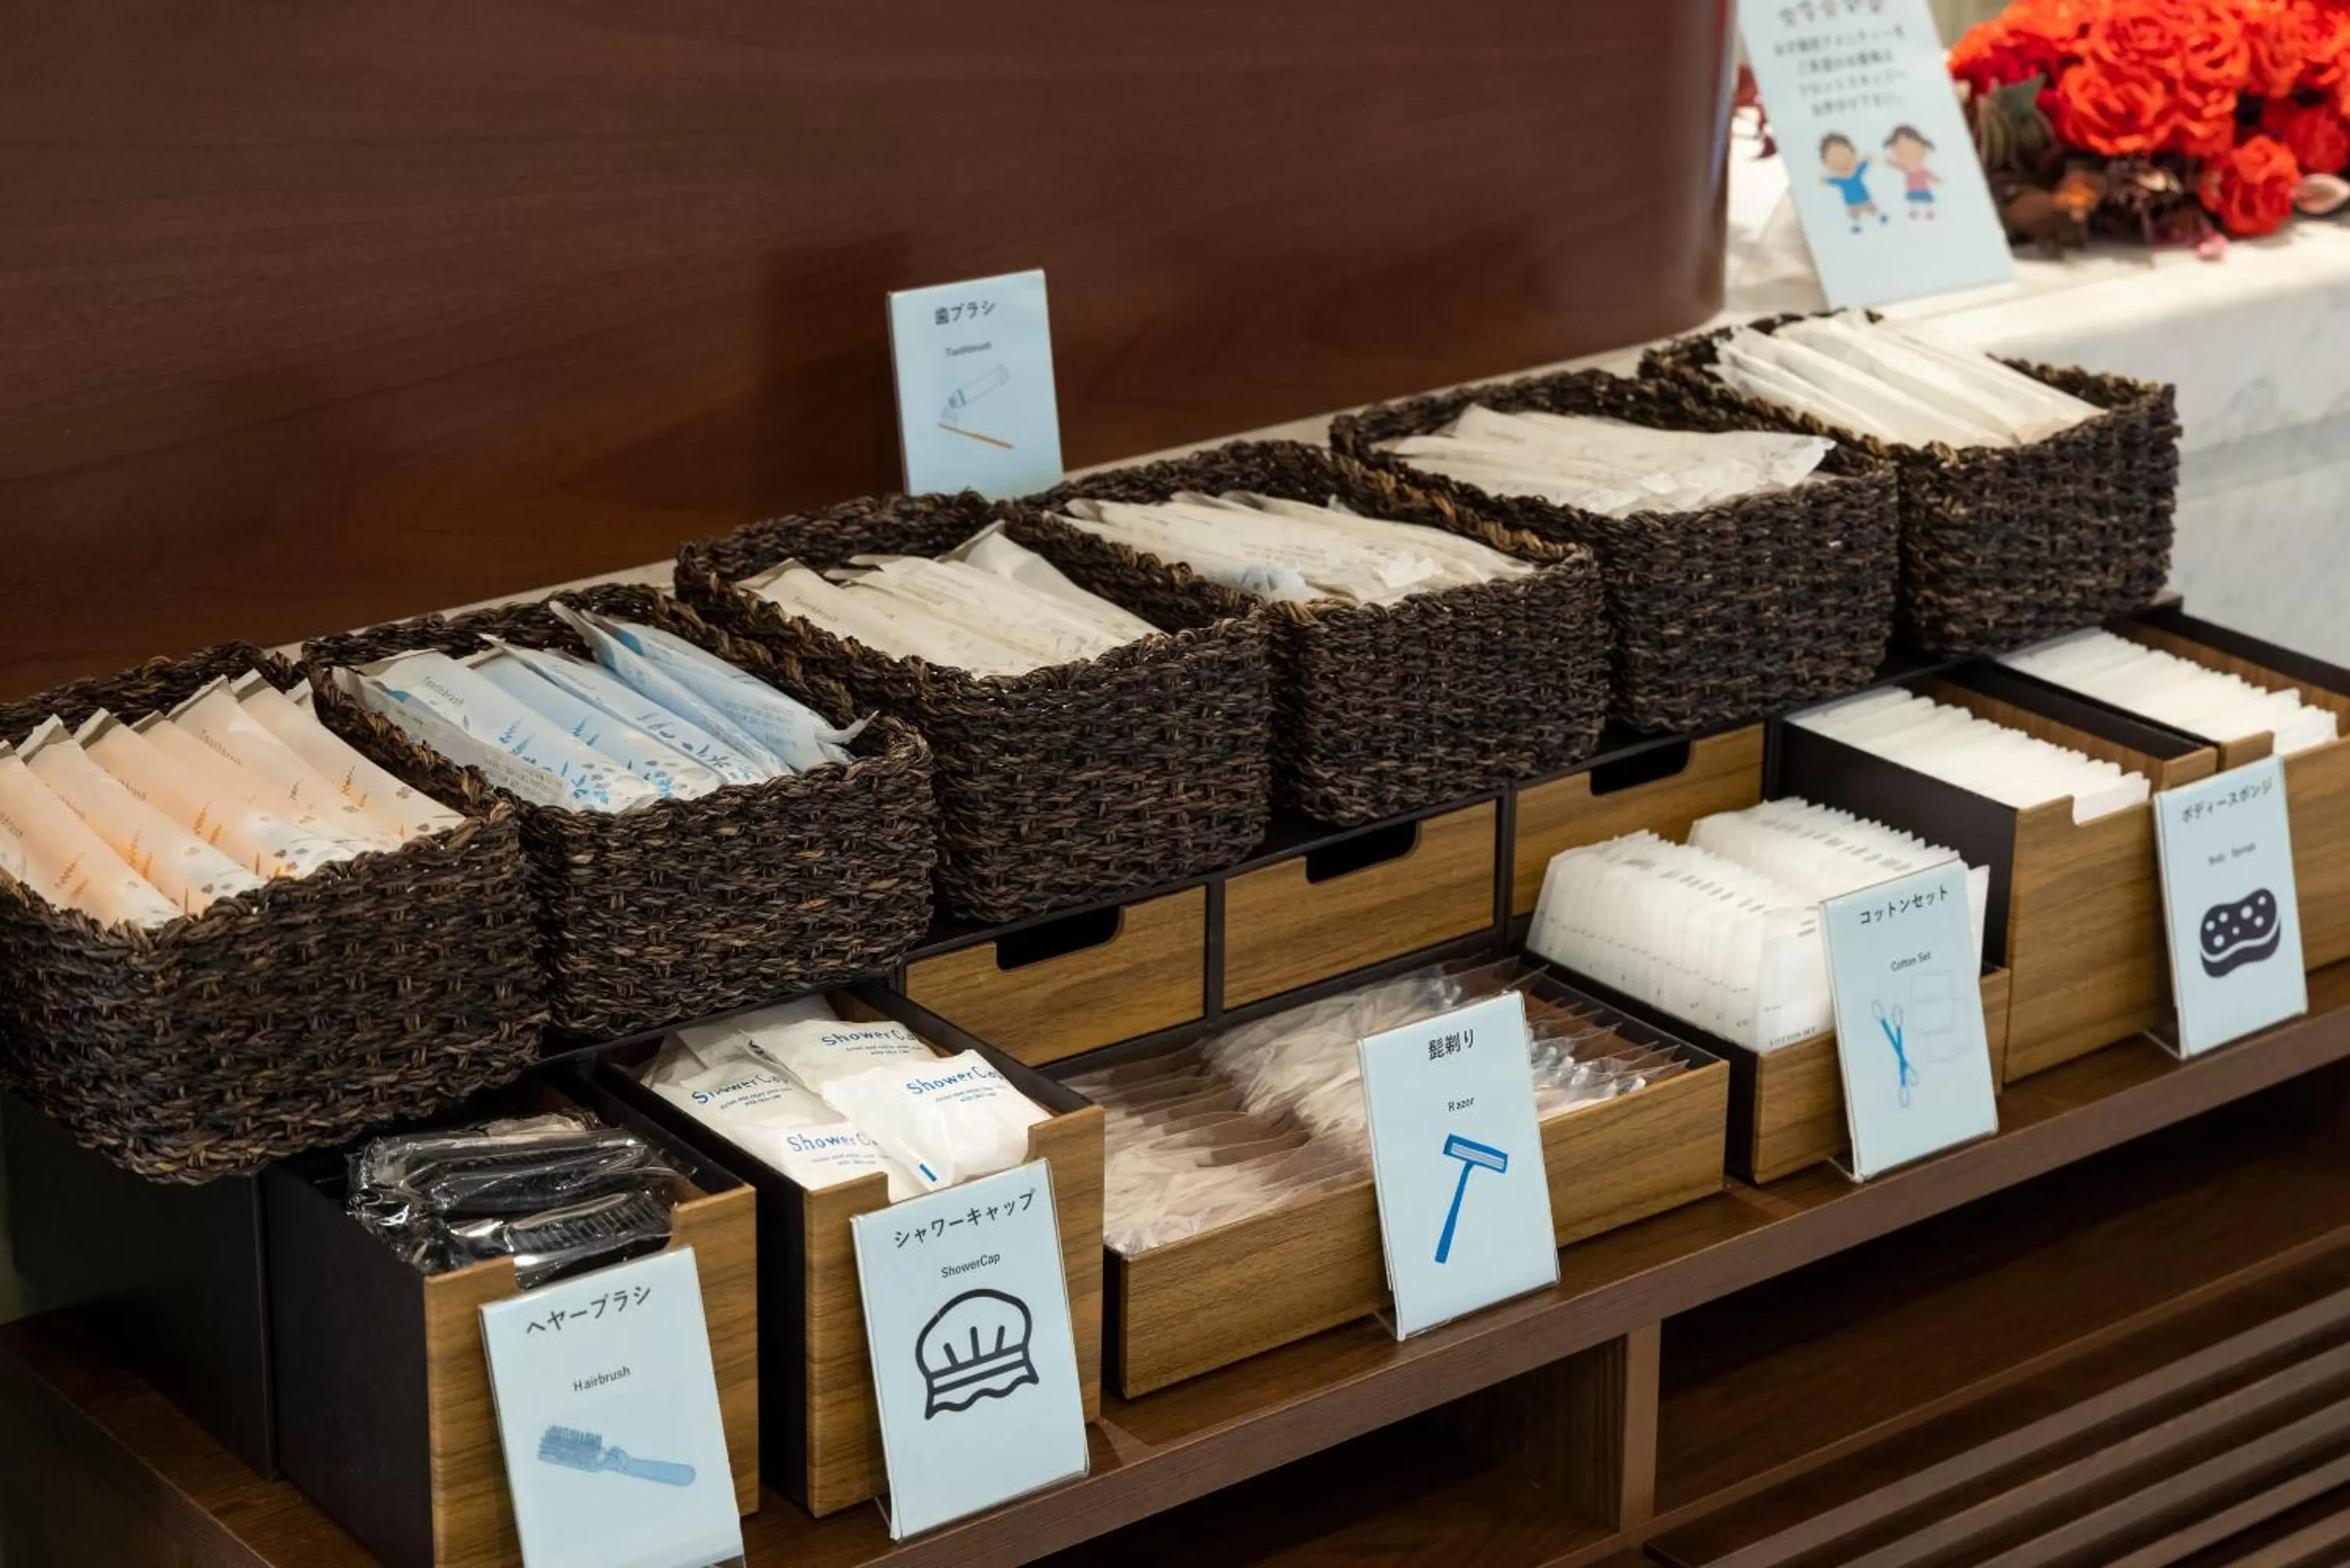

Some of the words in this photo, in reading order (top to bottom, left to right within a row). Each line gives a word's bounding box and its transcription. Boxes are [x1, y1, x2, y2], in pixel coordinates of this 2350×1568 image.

[1860, 883, 1948, 926] コットンセット
[1889, 956, 1917, 972] Cotton
[1918, 950, 1931, 963] Set
[821, 1028, 916, 1046] ShowerCa
[1428, 1028, 1473, 1061] 髭剃り
[1448, 1097, 1474, 1112] Razor
[894, 1187, 1036, 1248] シャワーキャップ
[940, 1252, 1001, 1278] ShowerCap
[526, 1285, 652, 1335] ヘヤーブラシ
[573, 1365, 631, 1392] Hairbrush
